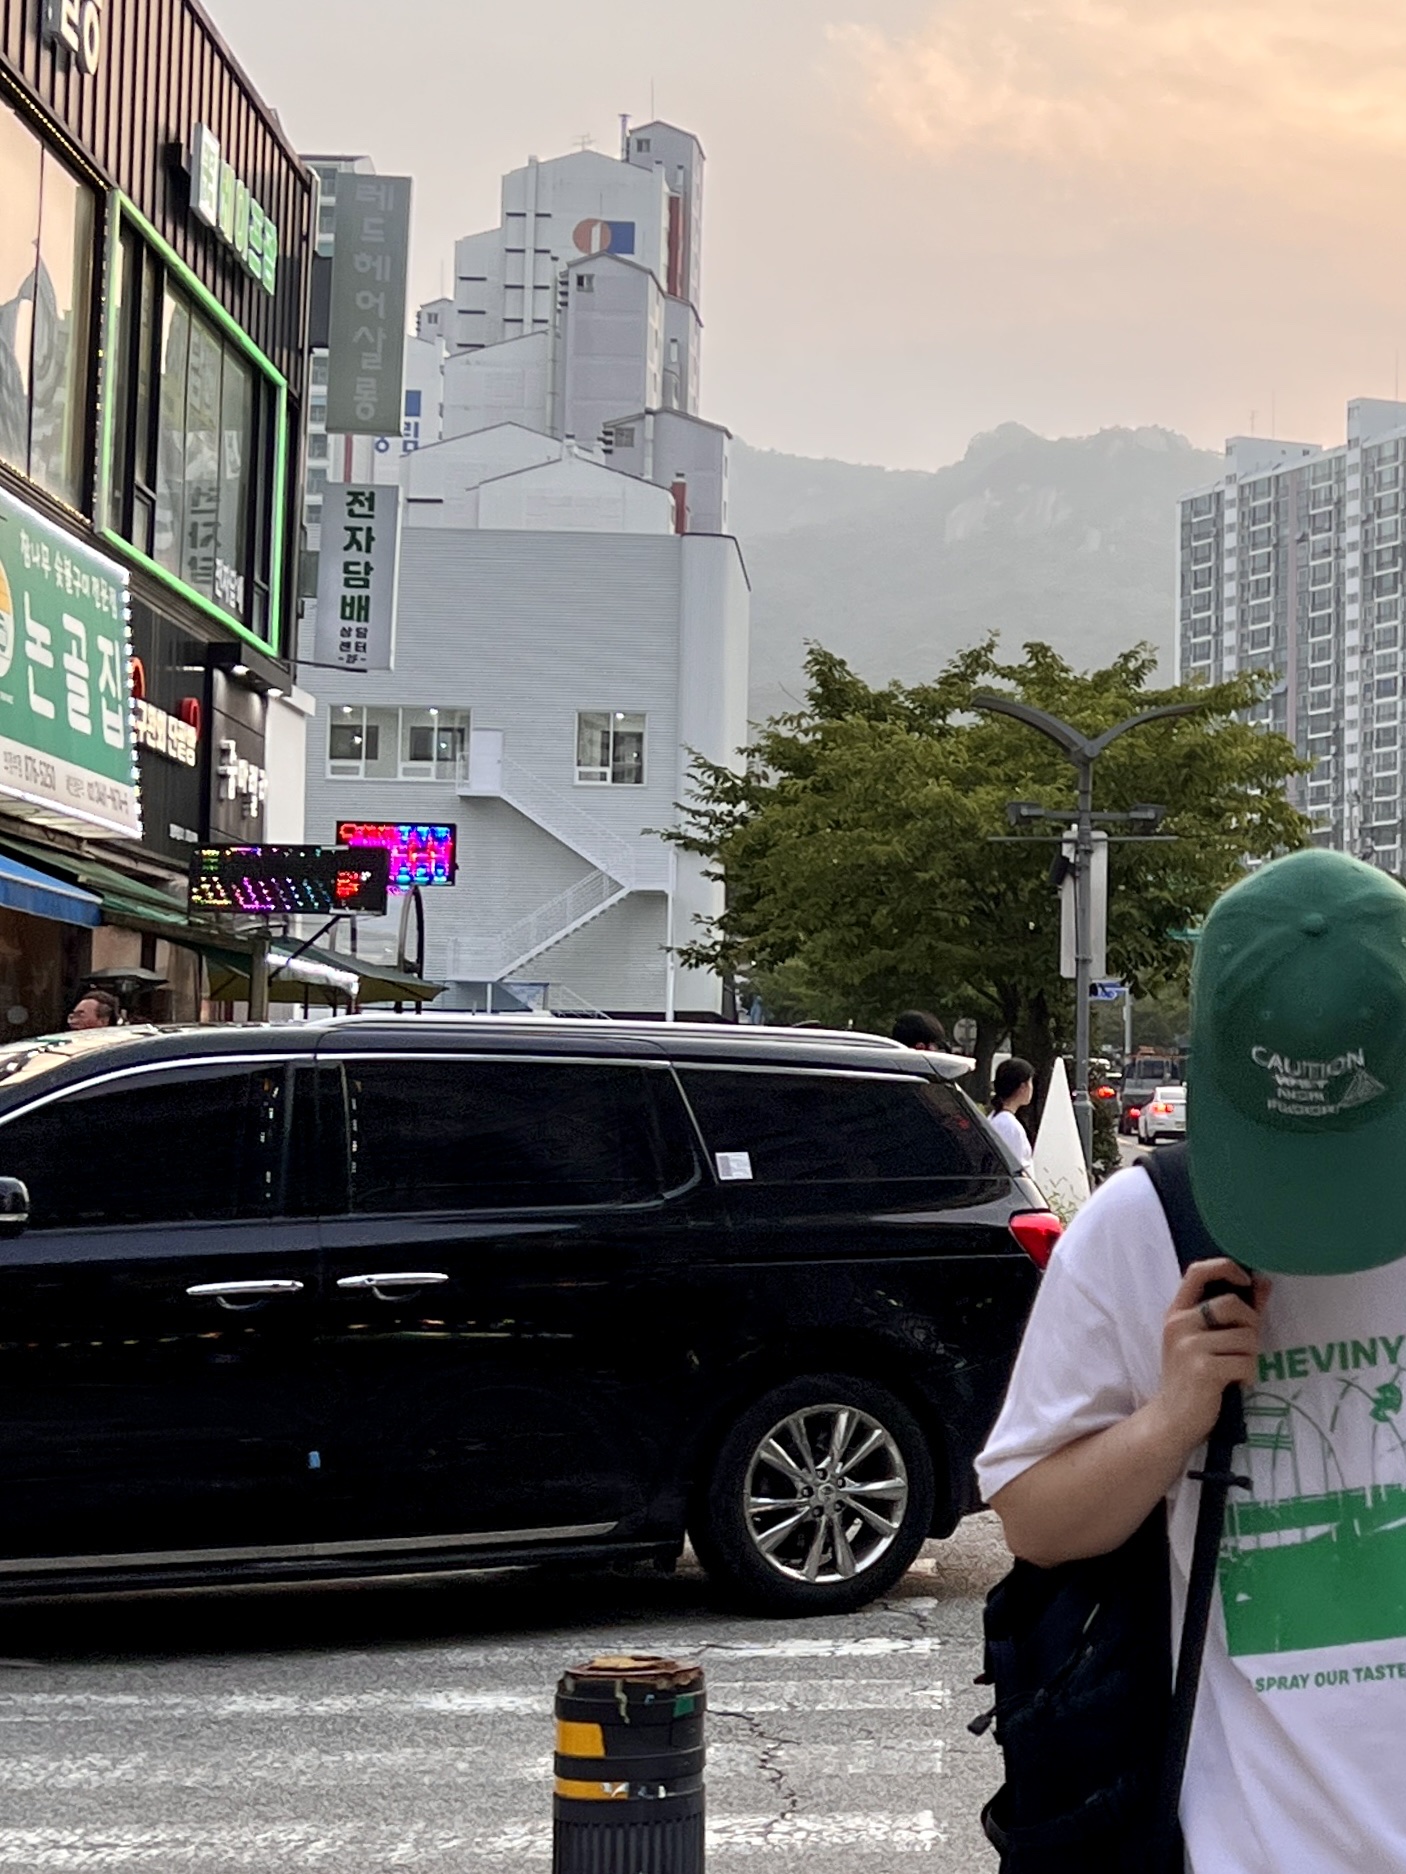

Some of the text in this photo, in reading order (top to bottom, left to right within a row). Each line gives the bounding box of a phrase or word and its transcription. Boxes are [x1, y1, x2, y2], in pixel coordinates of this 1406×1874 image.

[353, 183, 394, 421] 레드헤어살롱
[340, 491, 375, 623] 전자담배
[23, 590, 125, 750] 논골집
[1251, 1045, 1366, 1081] CAUTION
[1254, 1673, 1311, 1693] SPRAY
[1314, 1668, 1350, 1688] OUR
